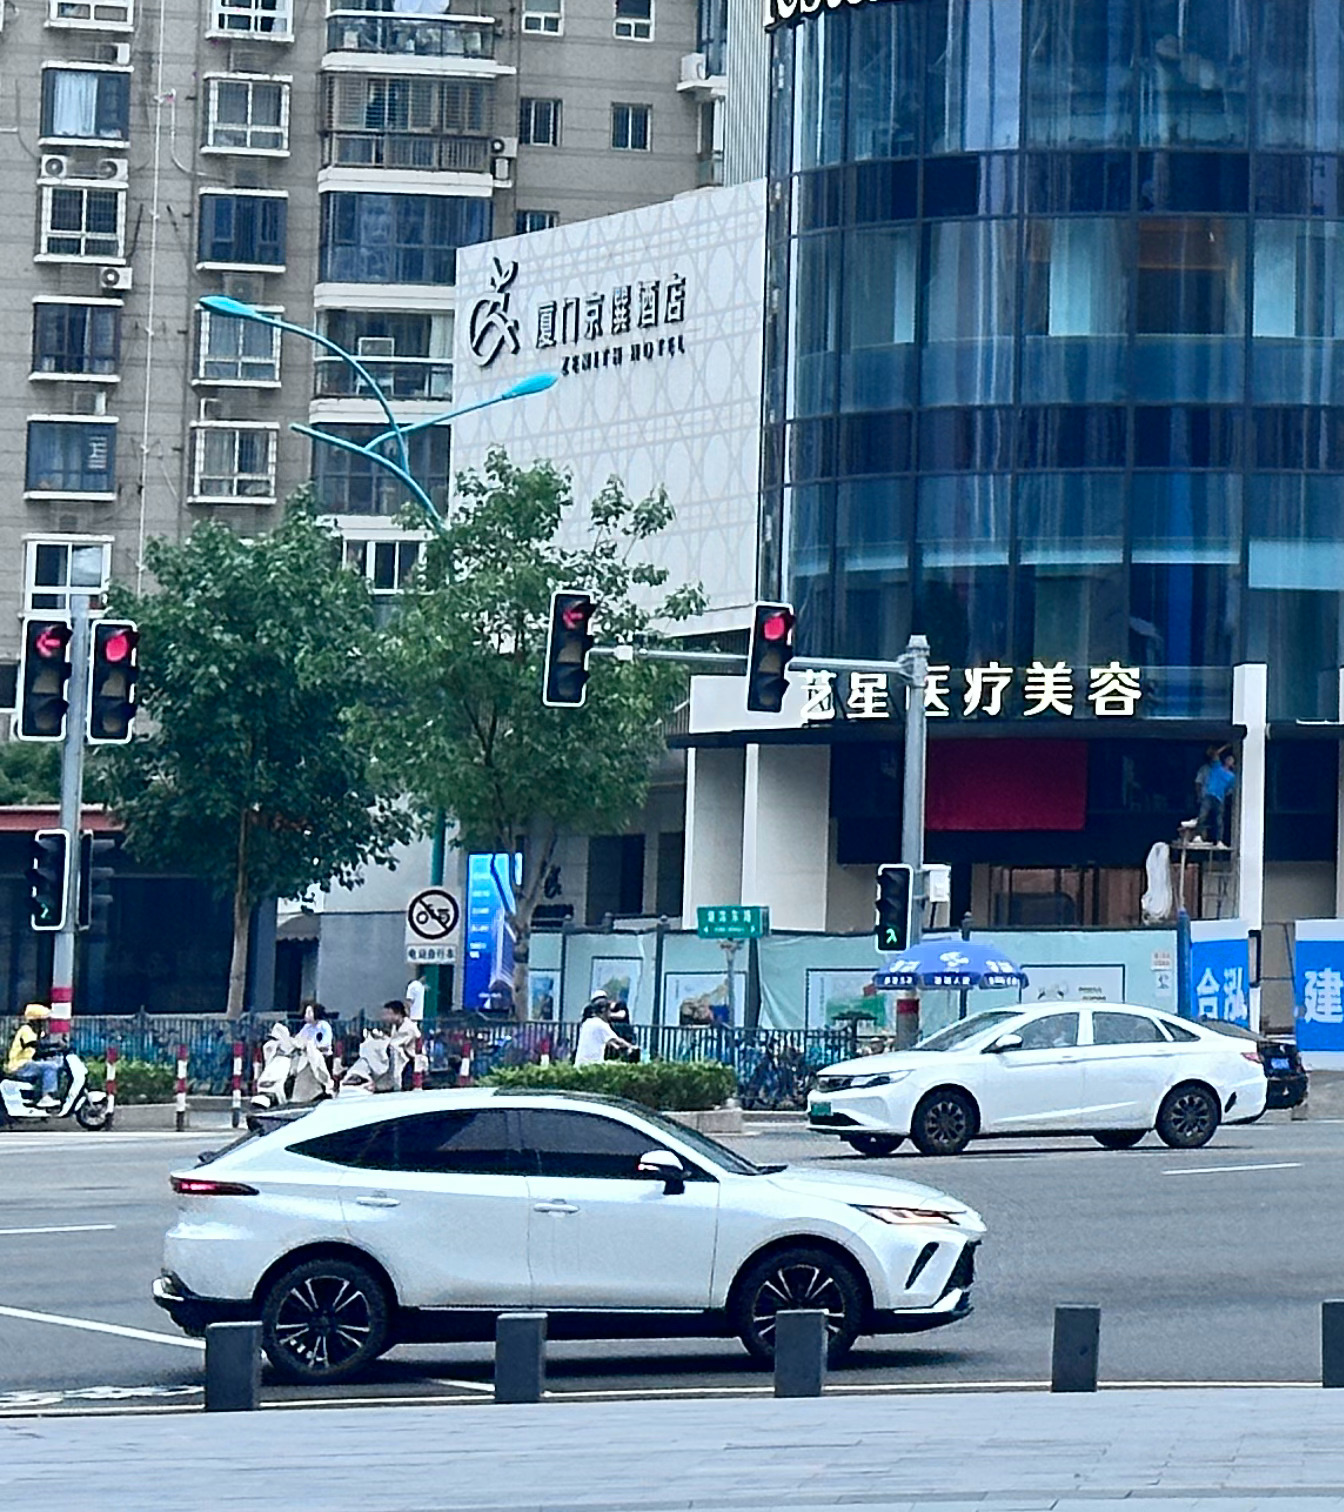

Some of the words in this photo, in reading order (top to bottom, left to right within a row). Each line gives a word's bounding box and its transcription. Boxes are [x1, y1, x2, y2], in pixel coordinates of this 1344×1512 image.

[797, 661, 1142, 722] 艺星医疗美容
